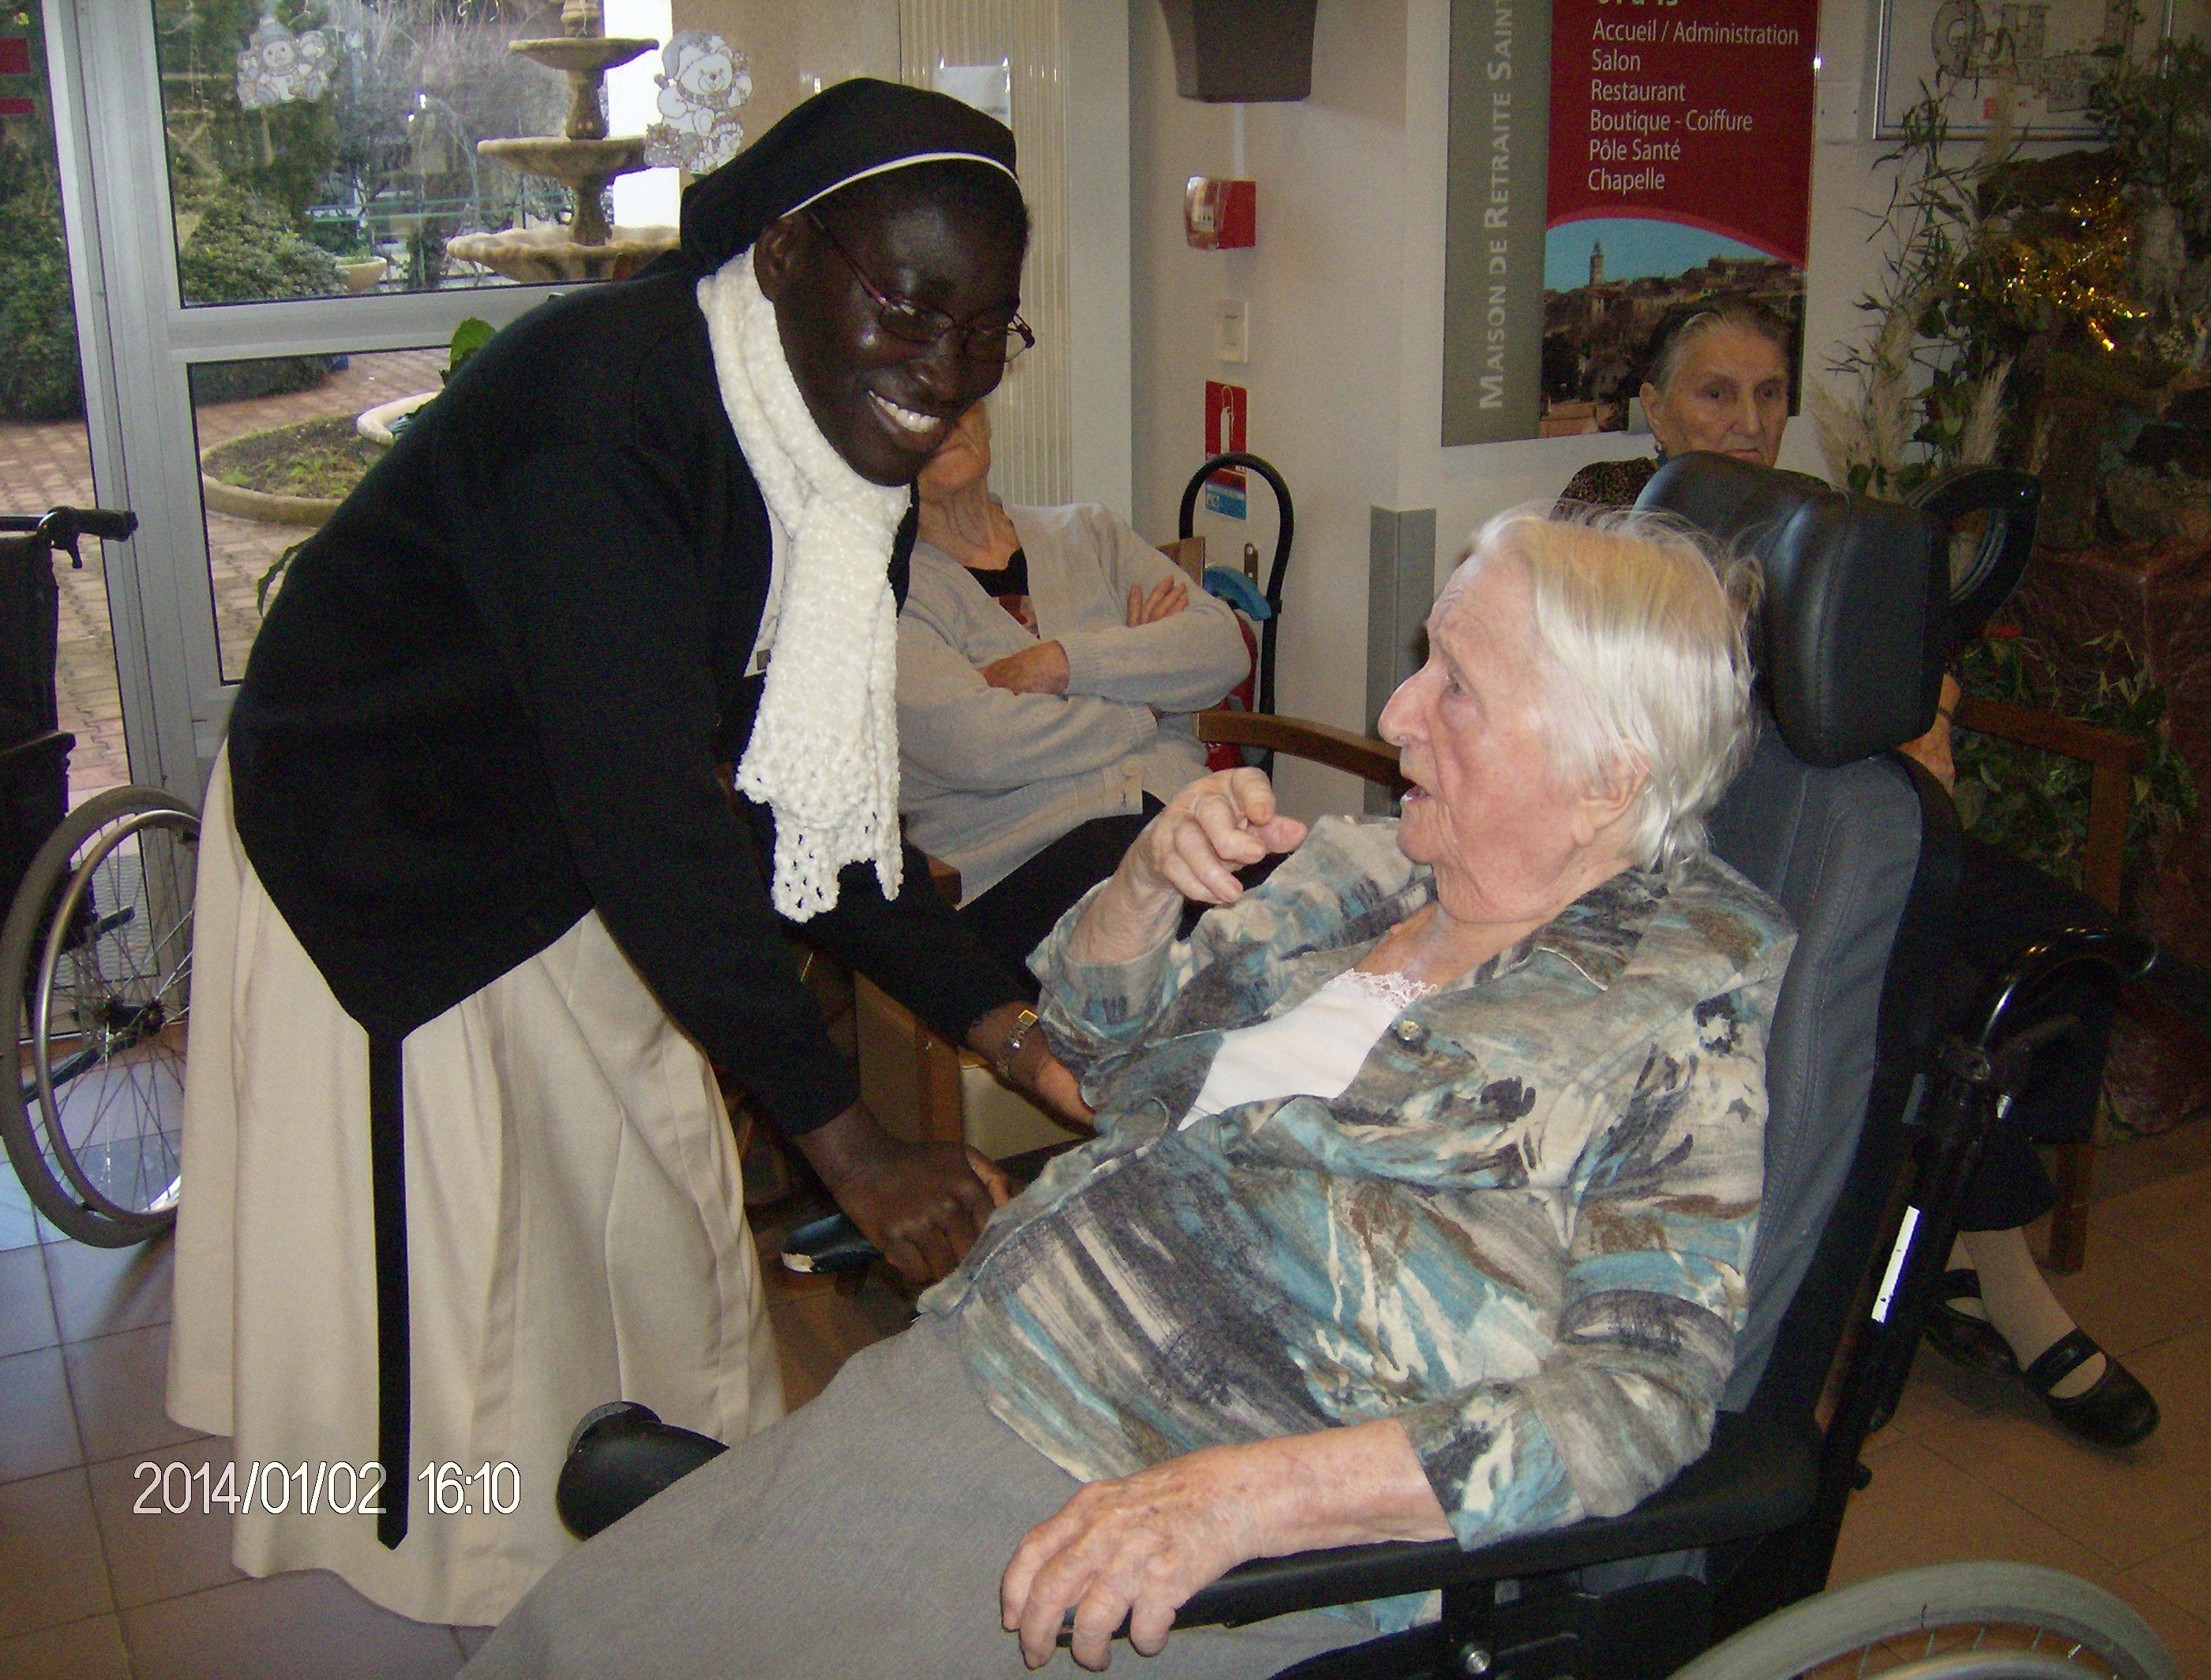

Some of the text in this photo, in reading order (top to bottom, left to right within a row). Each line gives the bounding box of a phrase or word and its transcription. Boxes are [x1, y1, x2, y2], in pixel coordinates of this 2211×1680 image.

[1592, 18, 1799, 44] Accueil / Administration
[1592, 49, 1641, 71] Salon
[1591, 78, 1686, 102] Restaurant
[1590, 108, 1671, 136] Boutique
[1686, 108, 1753, 132] Coiffure
[1485, 92, 1511, 228] RETRAITE
[1590, 138, 1681, 161] Pôle Santé
[1588, 167, 1665, 195] Chapelle
[1489, 240, 1507, 274] DE
[1480, 286, 1507, 409] MAISON
